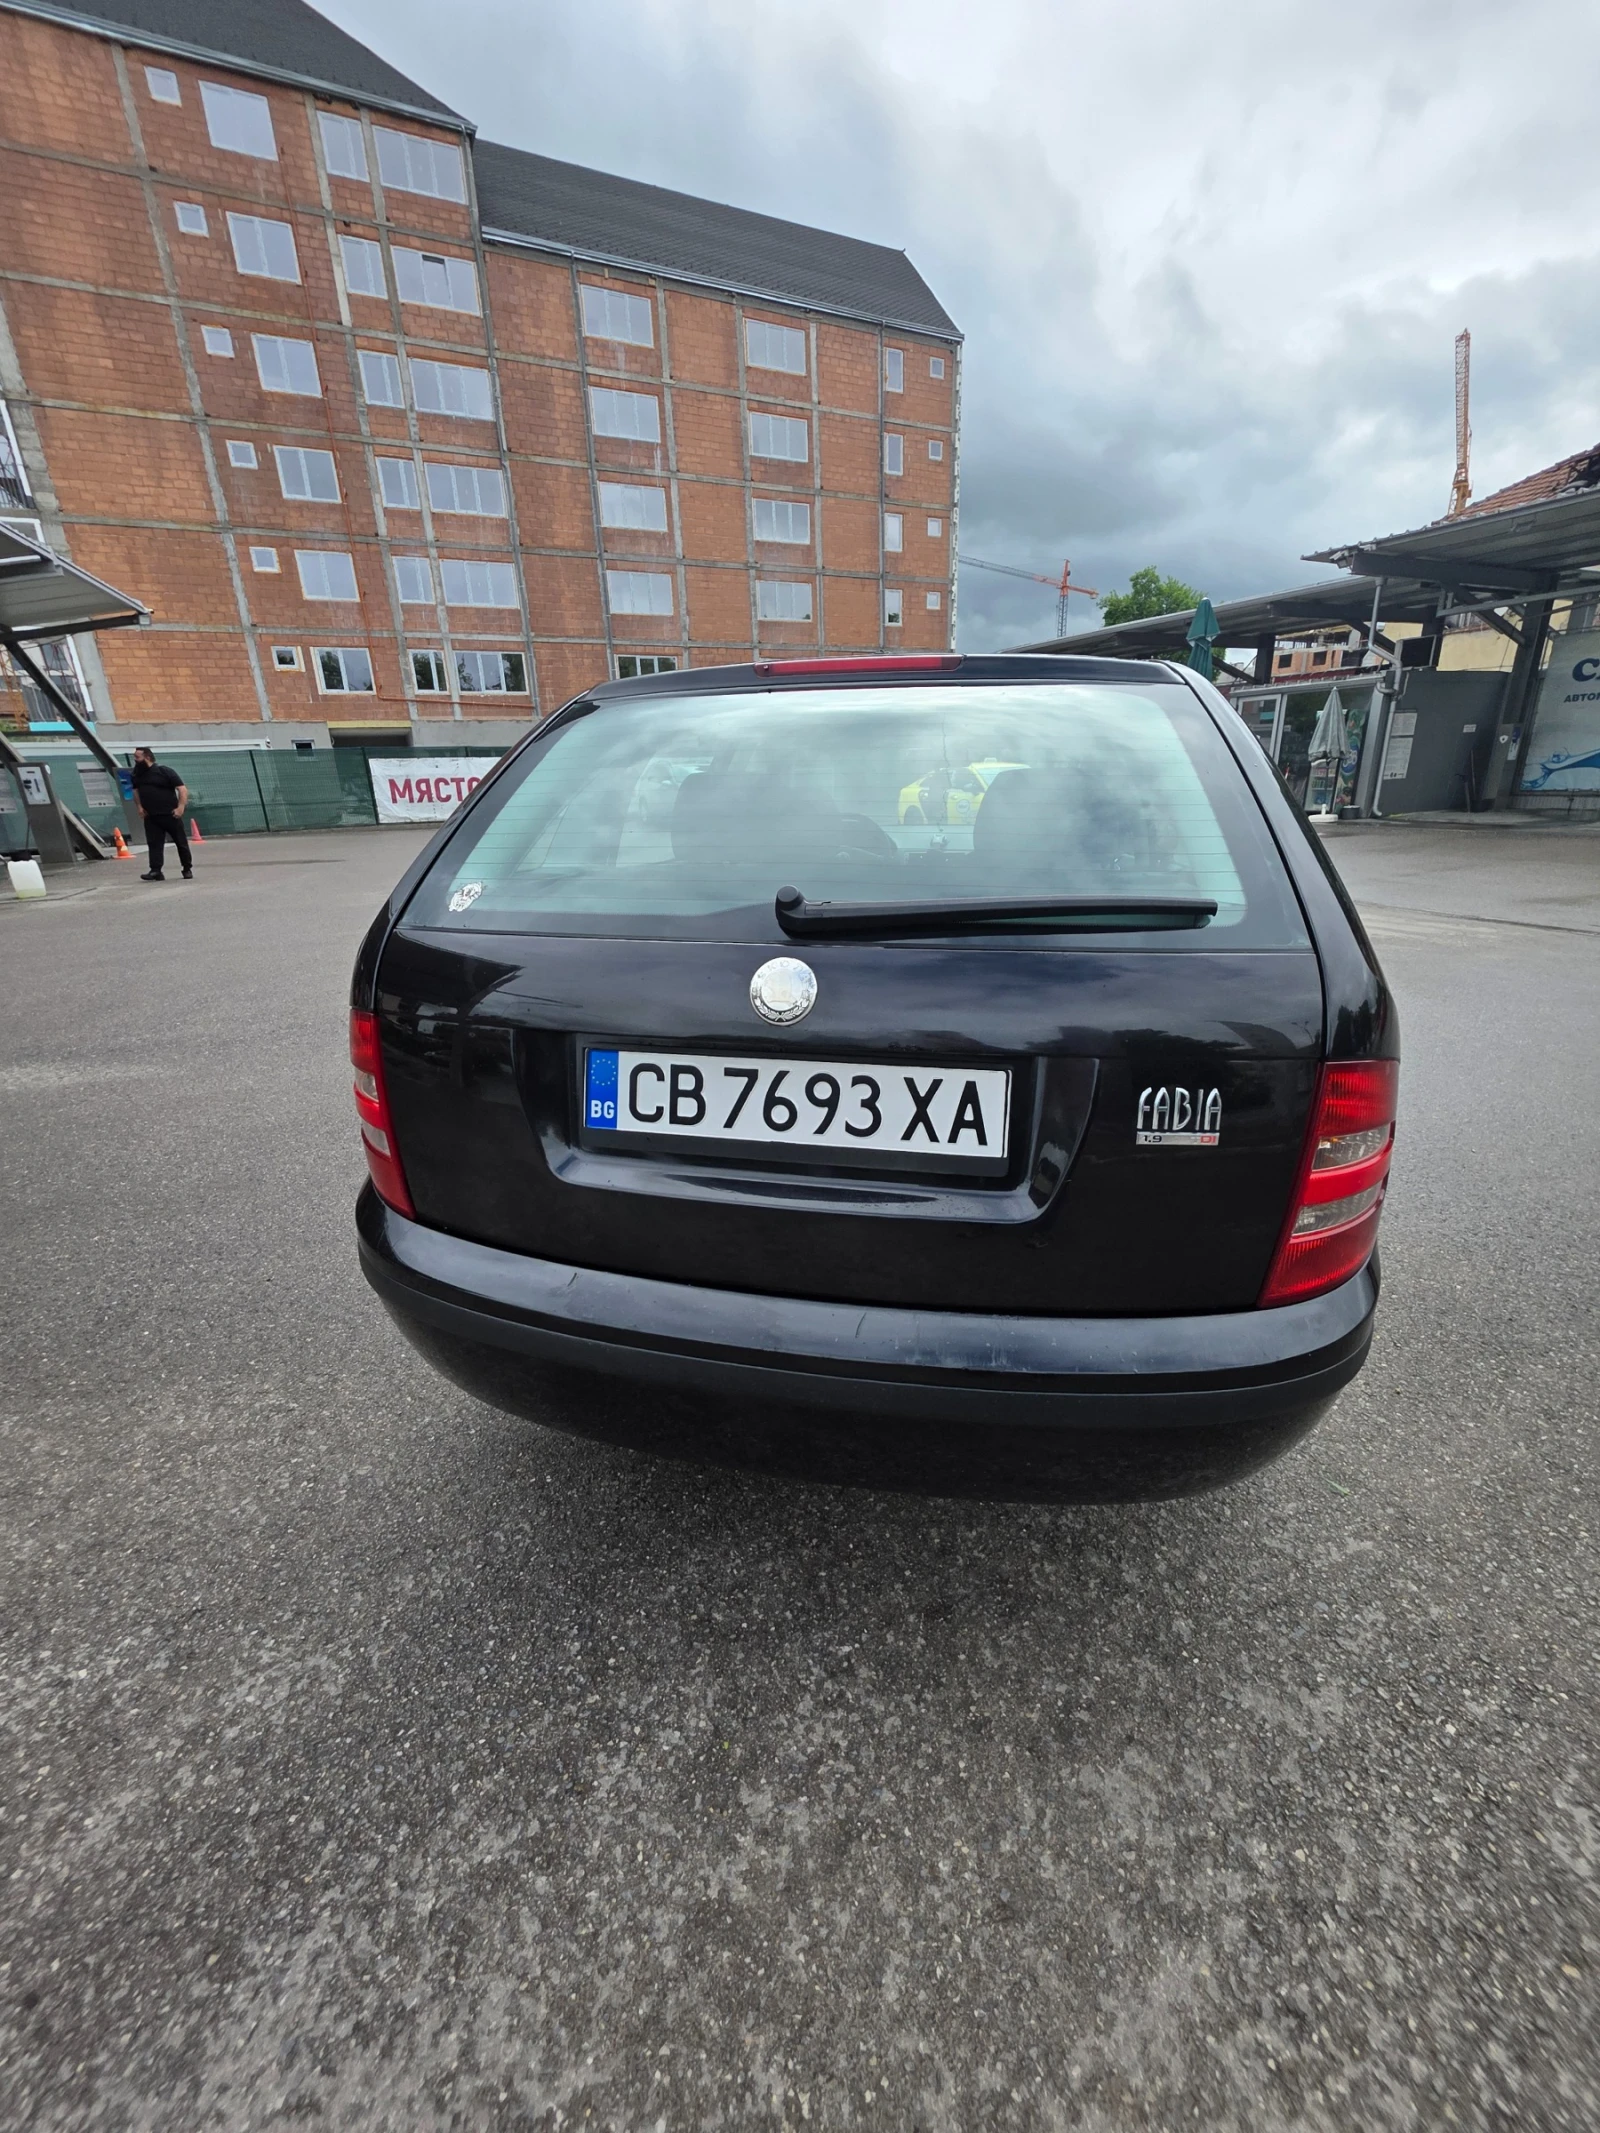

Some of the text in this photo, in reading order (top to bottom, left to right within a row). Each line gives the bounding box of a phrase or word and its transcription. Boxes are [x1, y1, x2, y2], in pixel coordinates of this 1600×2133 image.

[591, 1100, 615, 1119] BG
[1137, 1087, 1222, 1131] FABIA
[1144, 1135, 1162, 1143] 1.9
